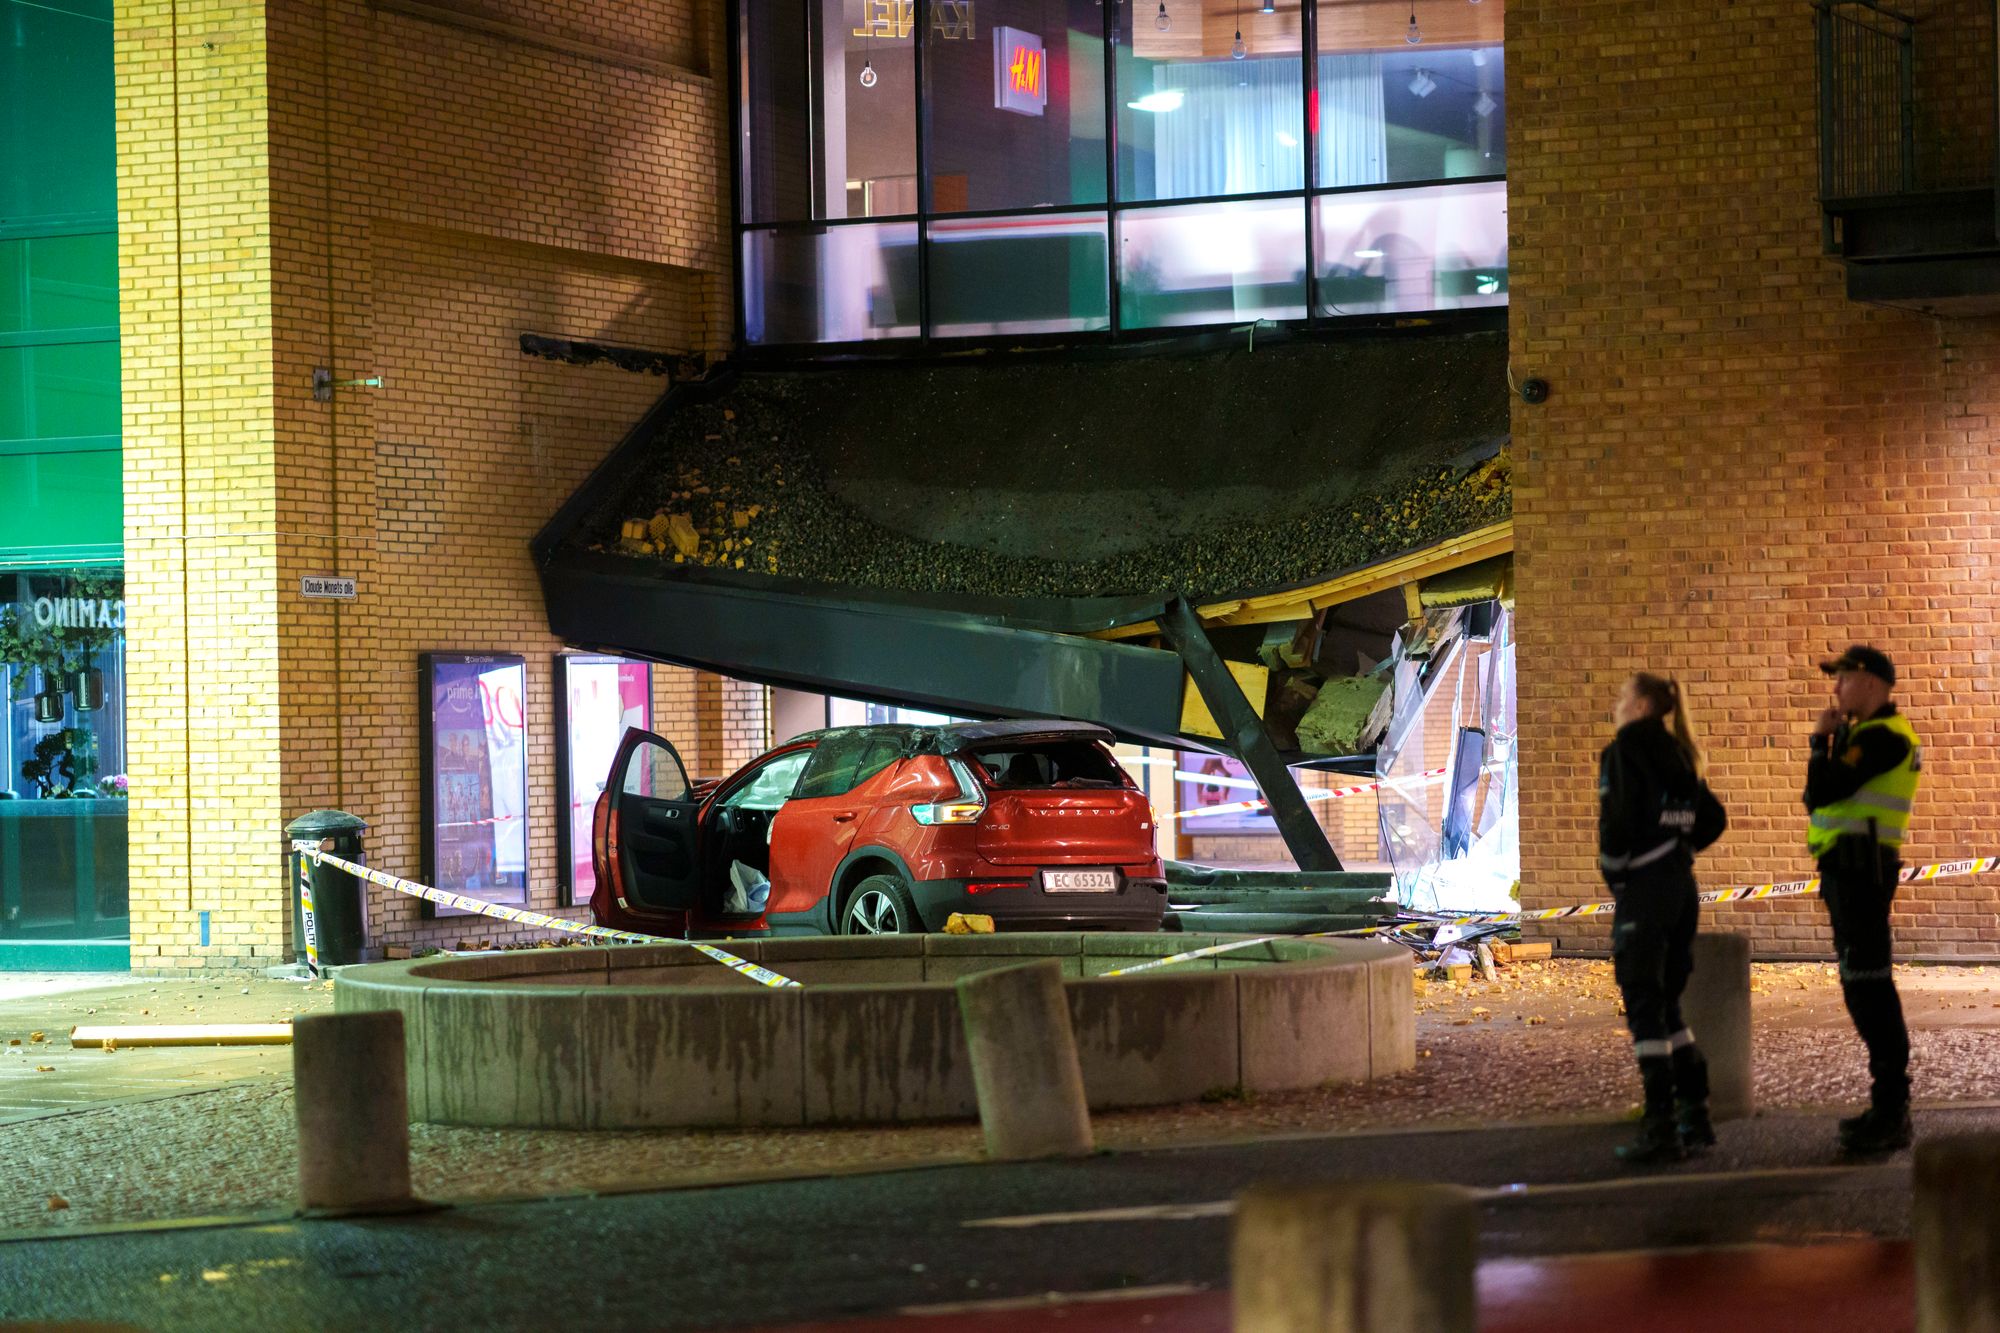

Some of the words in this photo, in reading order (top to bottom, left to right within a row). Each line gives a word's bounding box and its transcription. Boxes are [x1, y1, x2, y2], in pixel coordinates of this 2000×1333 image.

[1009, 46, 1041, 97] H&M
[304, 579, 322, 593] Claude
[324, 580, 343, 594] Monets
[447, 683, 474, 702] prime
[1040, 808, 1117, 816] VOLVO
[1940, 861, 1972, 874] POLITI
[1053, 873, 1070, 888] EC
[1073, 873, 1112, 888] 65324
[1771, 882, 1806, 893] POLITI
[304, 911, 316, 946] POLITI
[752, 966, 776, 981] POLITI
